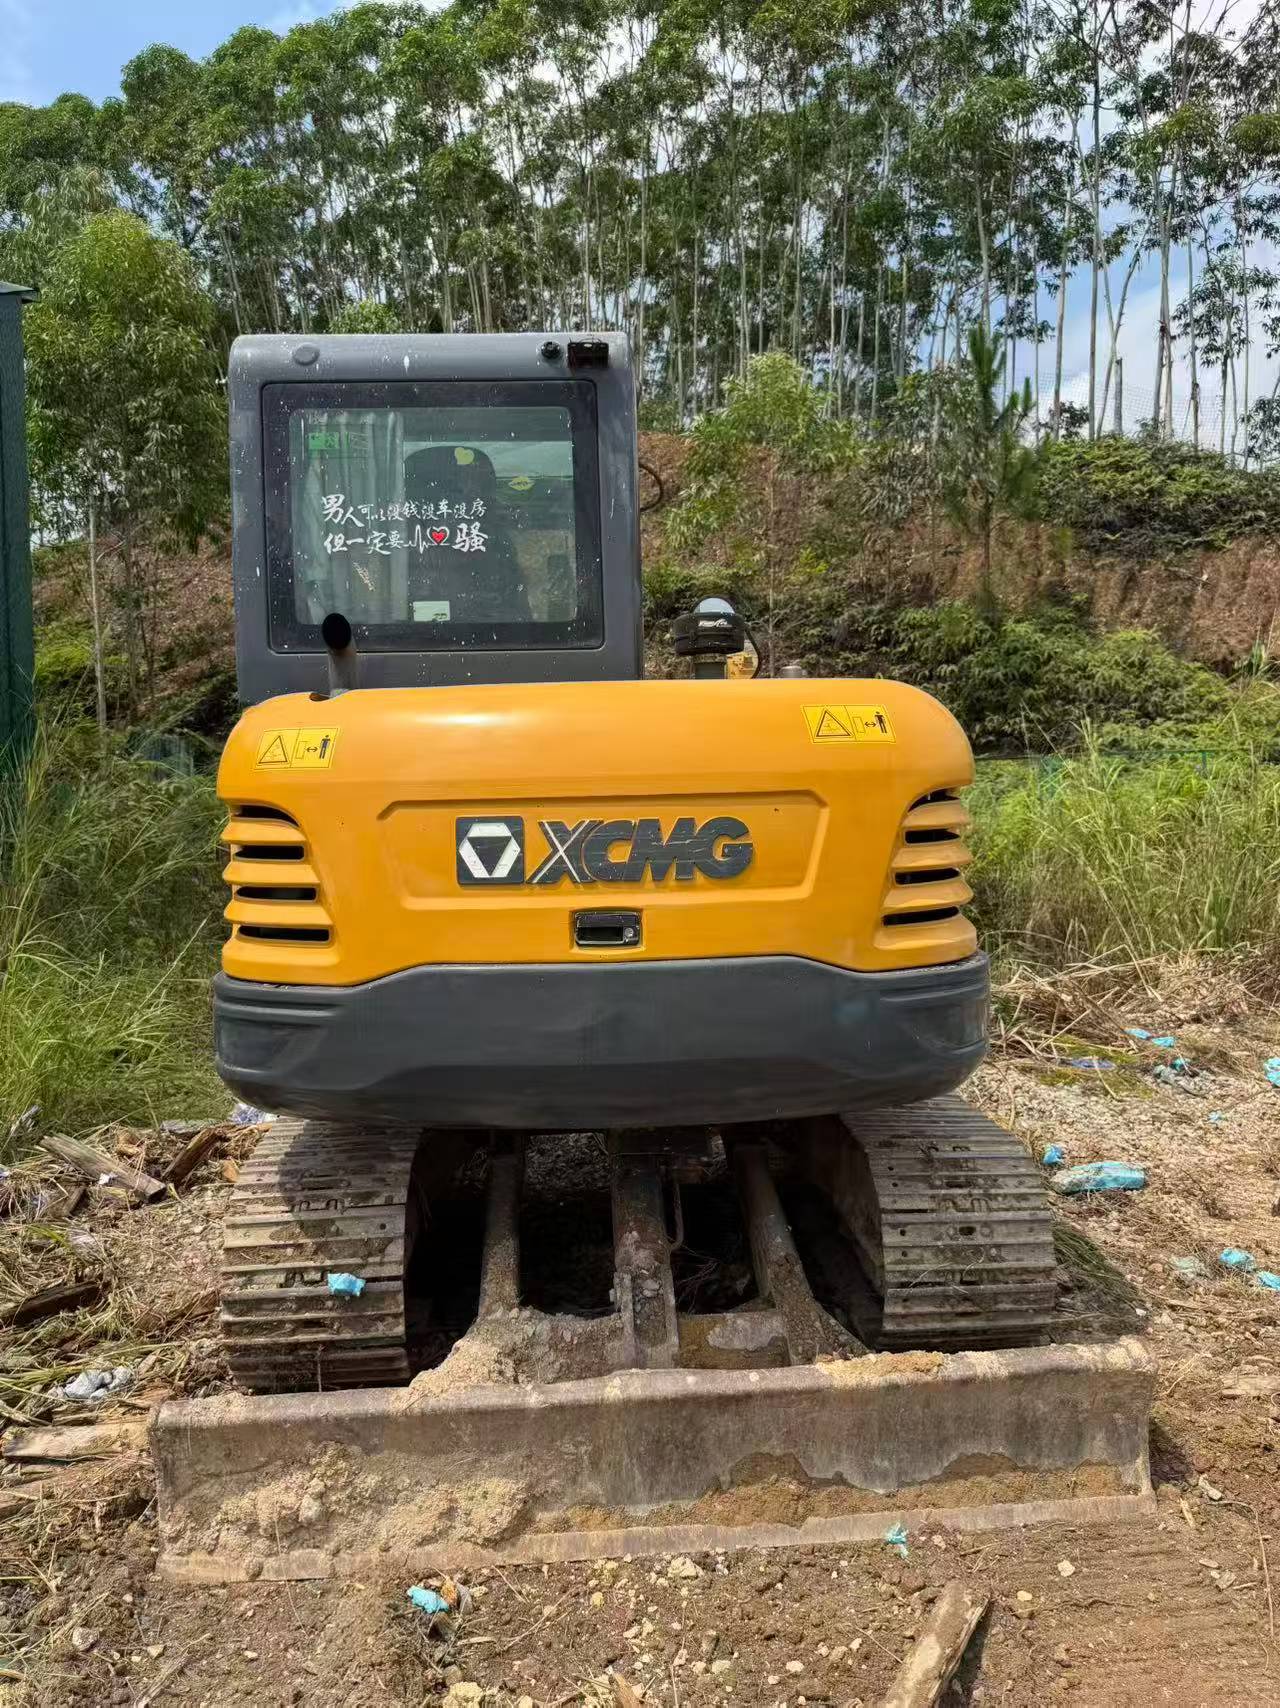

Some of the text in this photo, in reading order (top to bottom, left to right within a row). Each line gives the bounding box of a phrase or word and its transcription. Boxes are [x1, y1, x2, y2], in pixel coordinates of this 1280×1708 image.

[323, 522, 489, 556] 但一定要 骚
[525, 816, 754, 886] XCMG
